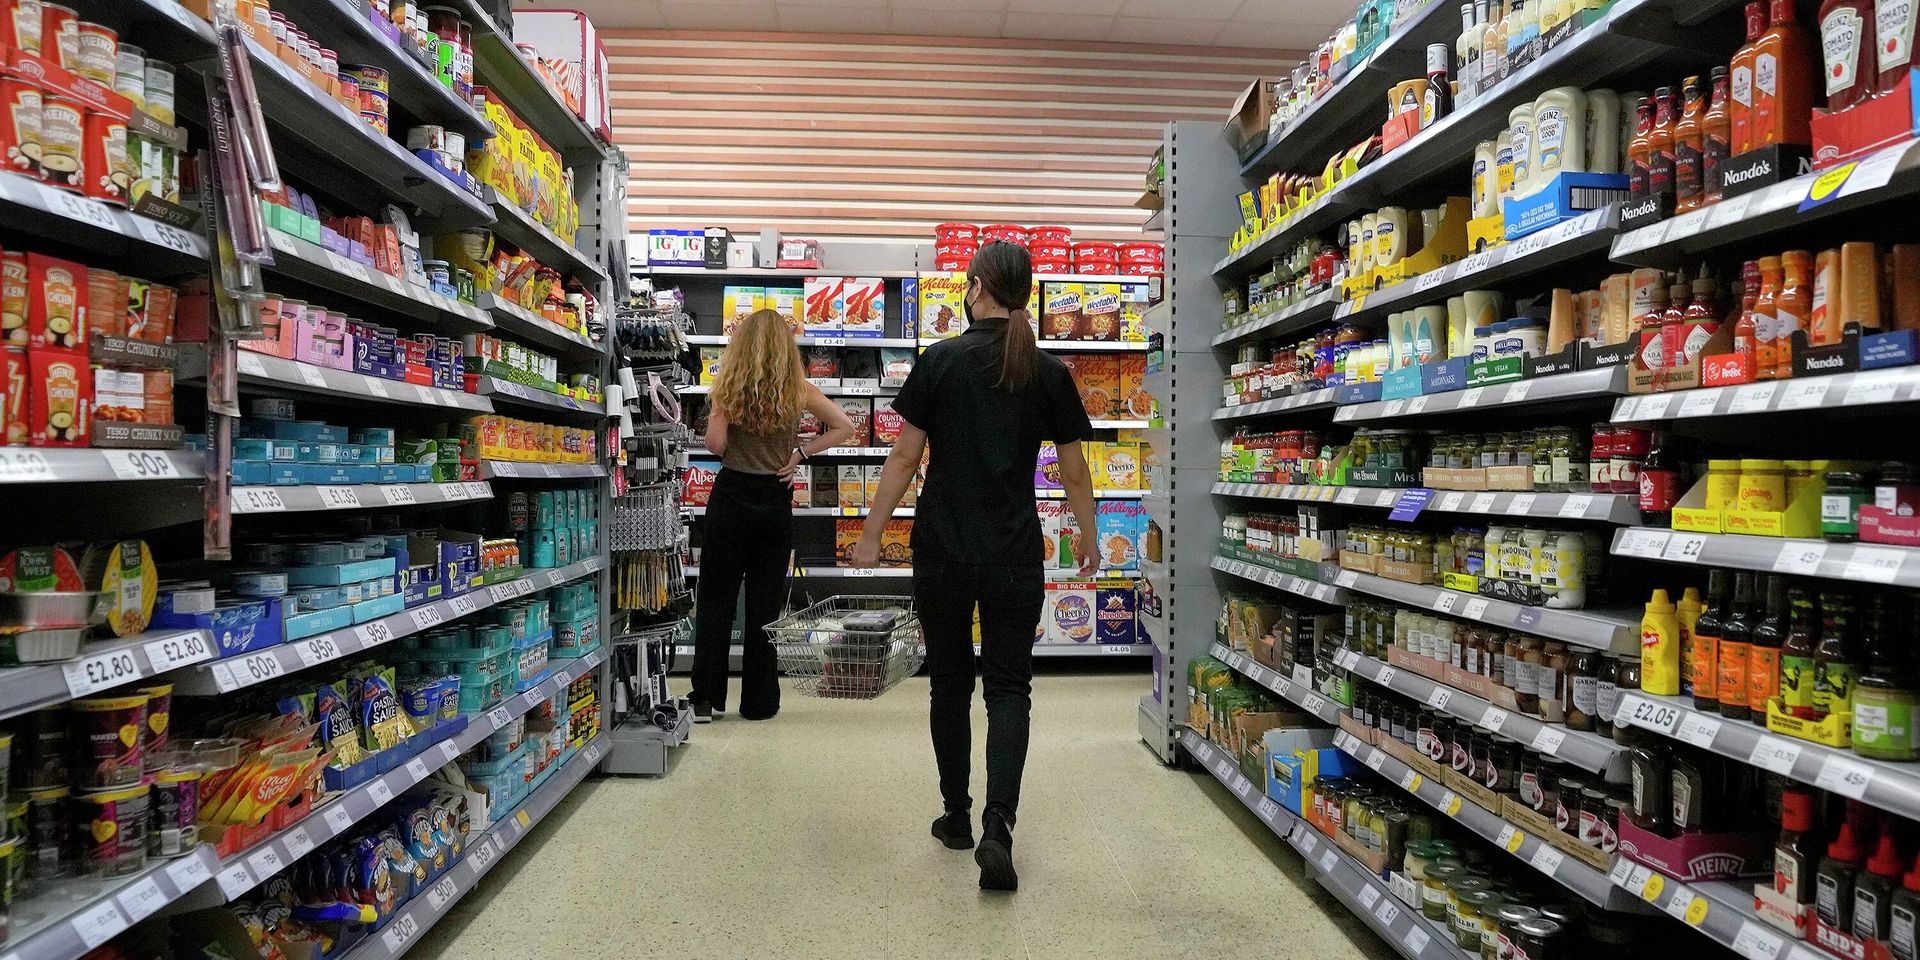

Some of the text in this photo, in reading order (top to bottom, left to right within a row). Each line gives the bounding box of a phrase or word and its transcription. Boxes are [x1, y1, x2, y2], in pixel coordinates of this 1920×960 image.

[1878, 4, 1909, 25] TOMATO
[1825, 16, 1848, 33] HEINZ
[1879, 15, 1908, 34] KETCHUP
[1824, 31, 1853, 49] TOMATO
[1825, 42, 1852, 60] KETCHUP
[43, 106, 77, 125] HEINZ
[1539, 111, 1558, 124] HEINZ
[211, 97, 229, 153] lumière
[1541, 130, 1556, 140] GOOD
[1723, 160, 1772, 187] Nando's
[1620, 199, 1657, 222] Nando's
[155, 222, 191, 251] 65p
[1515, 237, 1542, 255] £3.40
[1464, 254, 1489, 272] £3.40
[1049, 294, 1080, 309] Weetabix
[1087, 294, 1118, 309] Weetabix
[104, 340, 125, 352] TESCO
[127, 342, 160, 356] CHUNKY
[1495, 339, 1522, 349] HELLMANN'S
[1595, 353, 1619, 365] Nando's
[1806, 355, 1843, 370] Nando's
[1535, 362, 1556, 374] Nando's
[106, 428, 129, 440] TESCO
[131, 428, 163, 440] CHUNKY
[127, 452, 170, 475] 90p
[1107, 463, 1135, 473] Cheerios
[1394, 472, 1415, 482] Mrs
[249, 490, 282, 508] £1.35
[328, 489, 357, 506] £1.35
[390, 487, 413, 503] £1.35
[1742, 487, 1772, 500] Colman's
[1878, 526, 1914, 537] Redcurrant
[1683, 540, 1701, 556] £2
[420, 607, 440, 627] £1.70
[1055, 607, 1090, 618] Cheerios
[1098, 609, 1133, 620] Shreddies
[366, 622, 387, 643] 95p
[163, 636, 204, 662] £2.80
[308, 638, 334, 661] 95p
[87, 655, 134, 684] £2.80
[247, 656, 277, 680] 60p
[373, 697, 395, 713] PASTA
[373, 706, 397, 724] SAUCE
[495, 709, 511, 723] 90p
[1633, 702, 1676, 727] £2.05
[331, 718, 355, 738] SAUCE
[90, 733, 118, 741] NAKED
[261, 774, 293, 790] Mug
[264, 853, 277, 865] 75p
[476, 847, 491, 866] 55p
[1695, 858, 1739, 876] HEINZ
[233, 871, 248, 883] 75p
[437, 881, 455, 902] 90p
[393, 916, 413, 942] 90p
